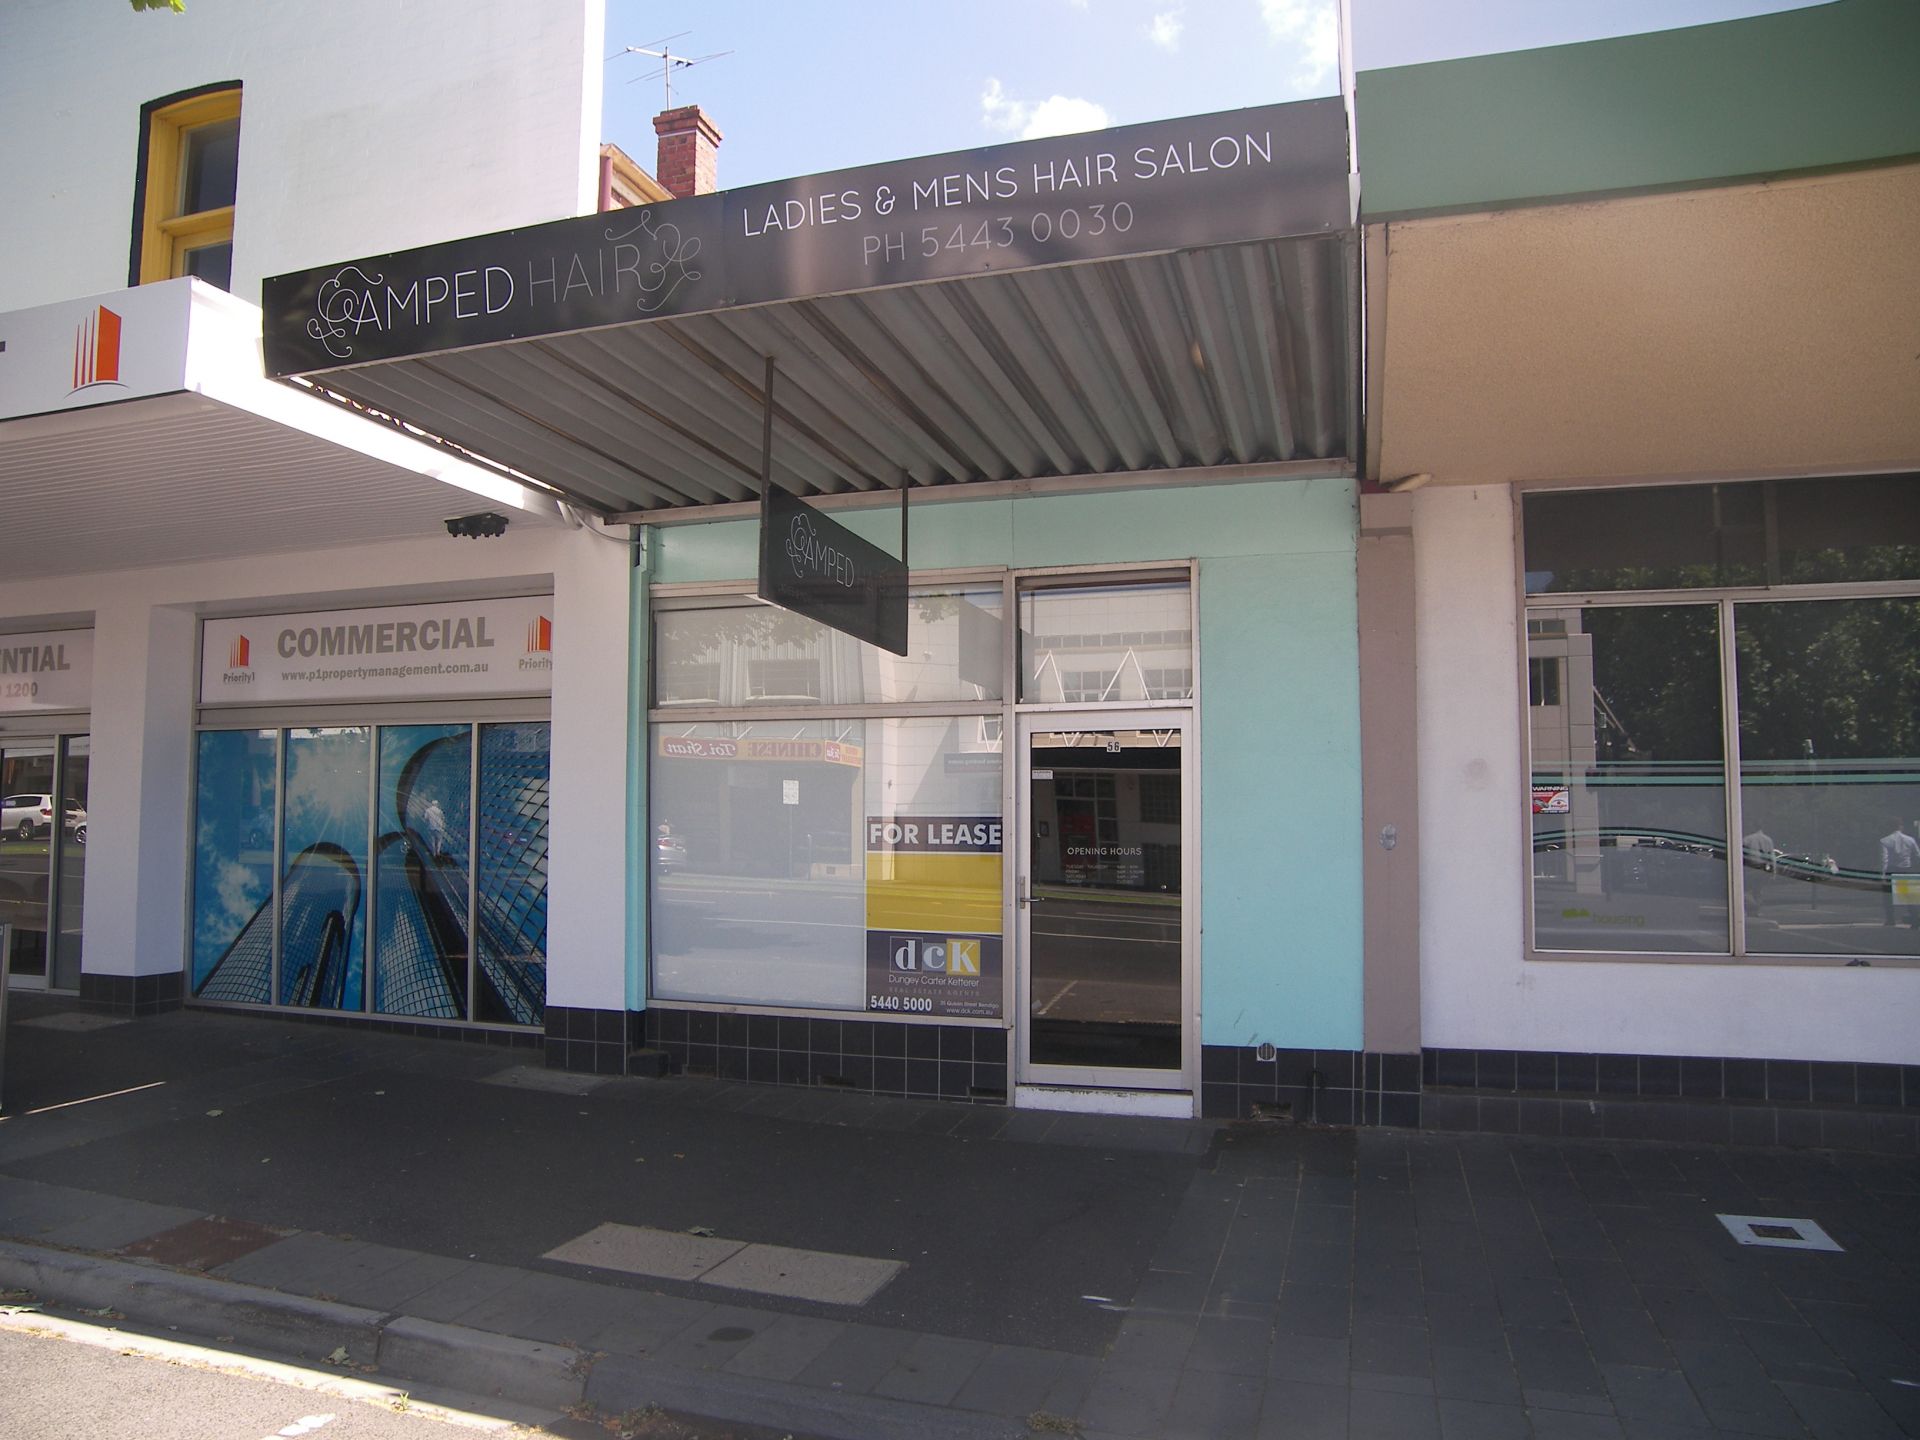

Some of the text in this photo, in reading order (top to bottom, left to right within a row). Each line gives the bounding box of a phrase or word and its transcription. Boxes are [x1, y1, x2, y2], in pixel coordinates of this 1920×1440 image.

[743, 131, 1272, 237] LADIES & MENS HAIR SALON
[863, 201, 1134, 266] PH 5443 0030
[528, 226, 675, 309] HAIR
[277, 616, 495, 659] COMMERCIAL
[281, 662, 489, 681] www.p1propertymanagement.com.au
[1106, 741, 1120, 752] 56
[870, 823, 1002, 846] FOR LEASE
[1067, 847, 1142, 855] OPENING HOURS
[889, 974, 920, 985] Dungey
[870, 995, 899, 1009] 5440
[903, 997, 932, 1011] 5000
